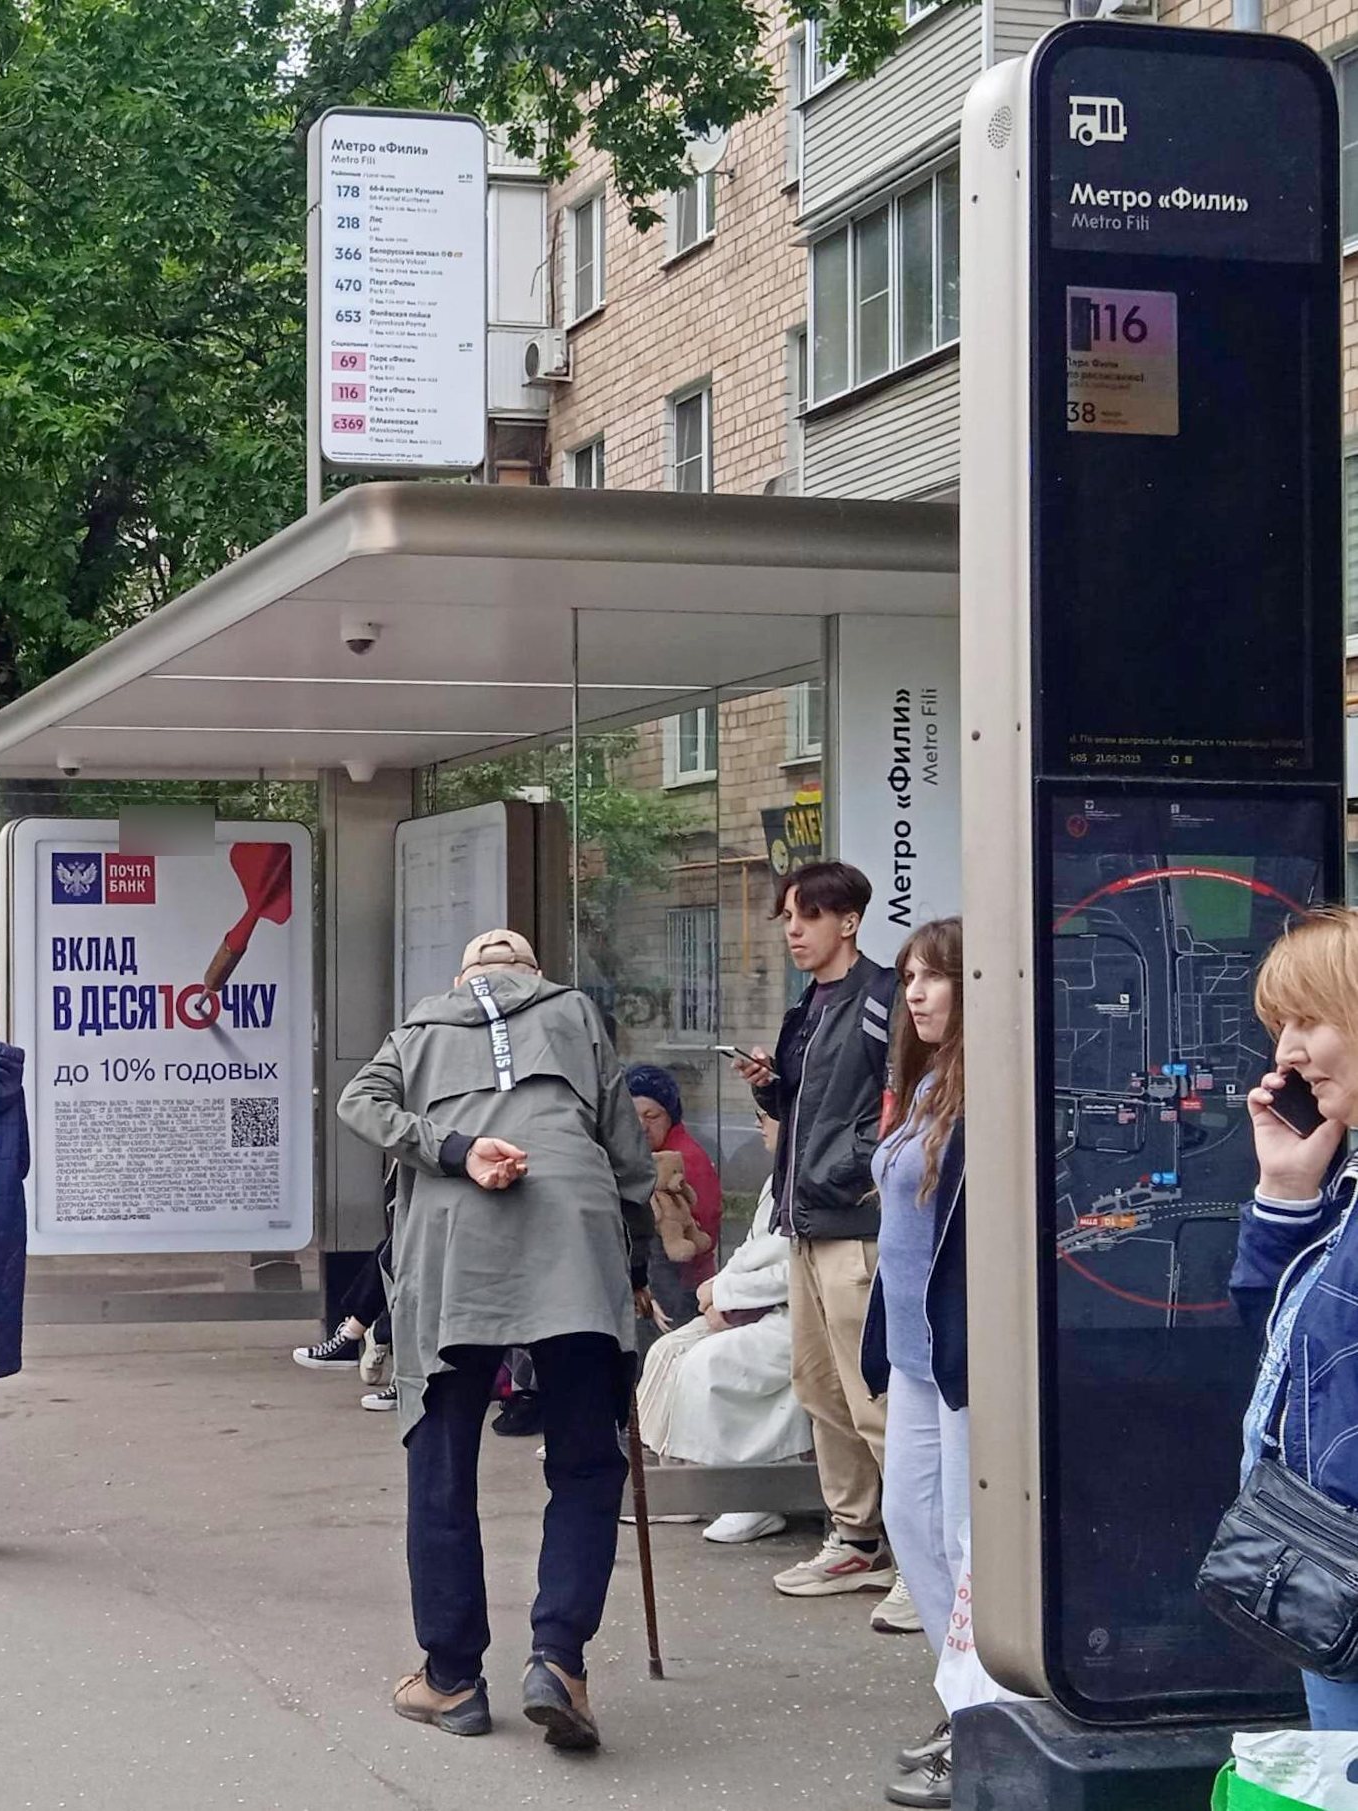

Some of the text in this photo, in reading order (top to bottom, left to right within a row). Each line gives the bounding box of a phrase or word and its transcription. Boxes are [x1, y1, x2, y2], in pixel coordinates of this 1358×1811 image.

[331, 138, 429, 156] Метро «Фили»
[331, 154, 376, 165] Metro Fili
[336, 185, 360, 198] 178
[1070, 183, 1249, 213] Метро «Фили»
[337, 216, 360, 229] 218
[1071, 212, 1150, 231] Metro Fili
[335, 248, 362, 261] 366
[369, 247, 414, 258] Белорусский
[335, 279, 362, 292] 470
[335, 310, 362, 324] 653
[1090, 303, 1148, 344] 116
[340, 356, 357, 368] 69
[339, 386, 358, 399] 116
[922, 688, 938, 786] Metro Fili
[887, 688, 917, 928] Метро «Фили»
[110, 864, 150, 878] ПОЧТА
[110, 879, 146, 892] БАНК
[52, 936, 138, 975] ВКЛАД
[54, 985, 72, 1031] В
[54, 1058, 278, 1086] до 10% годовых
